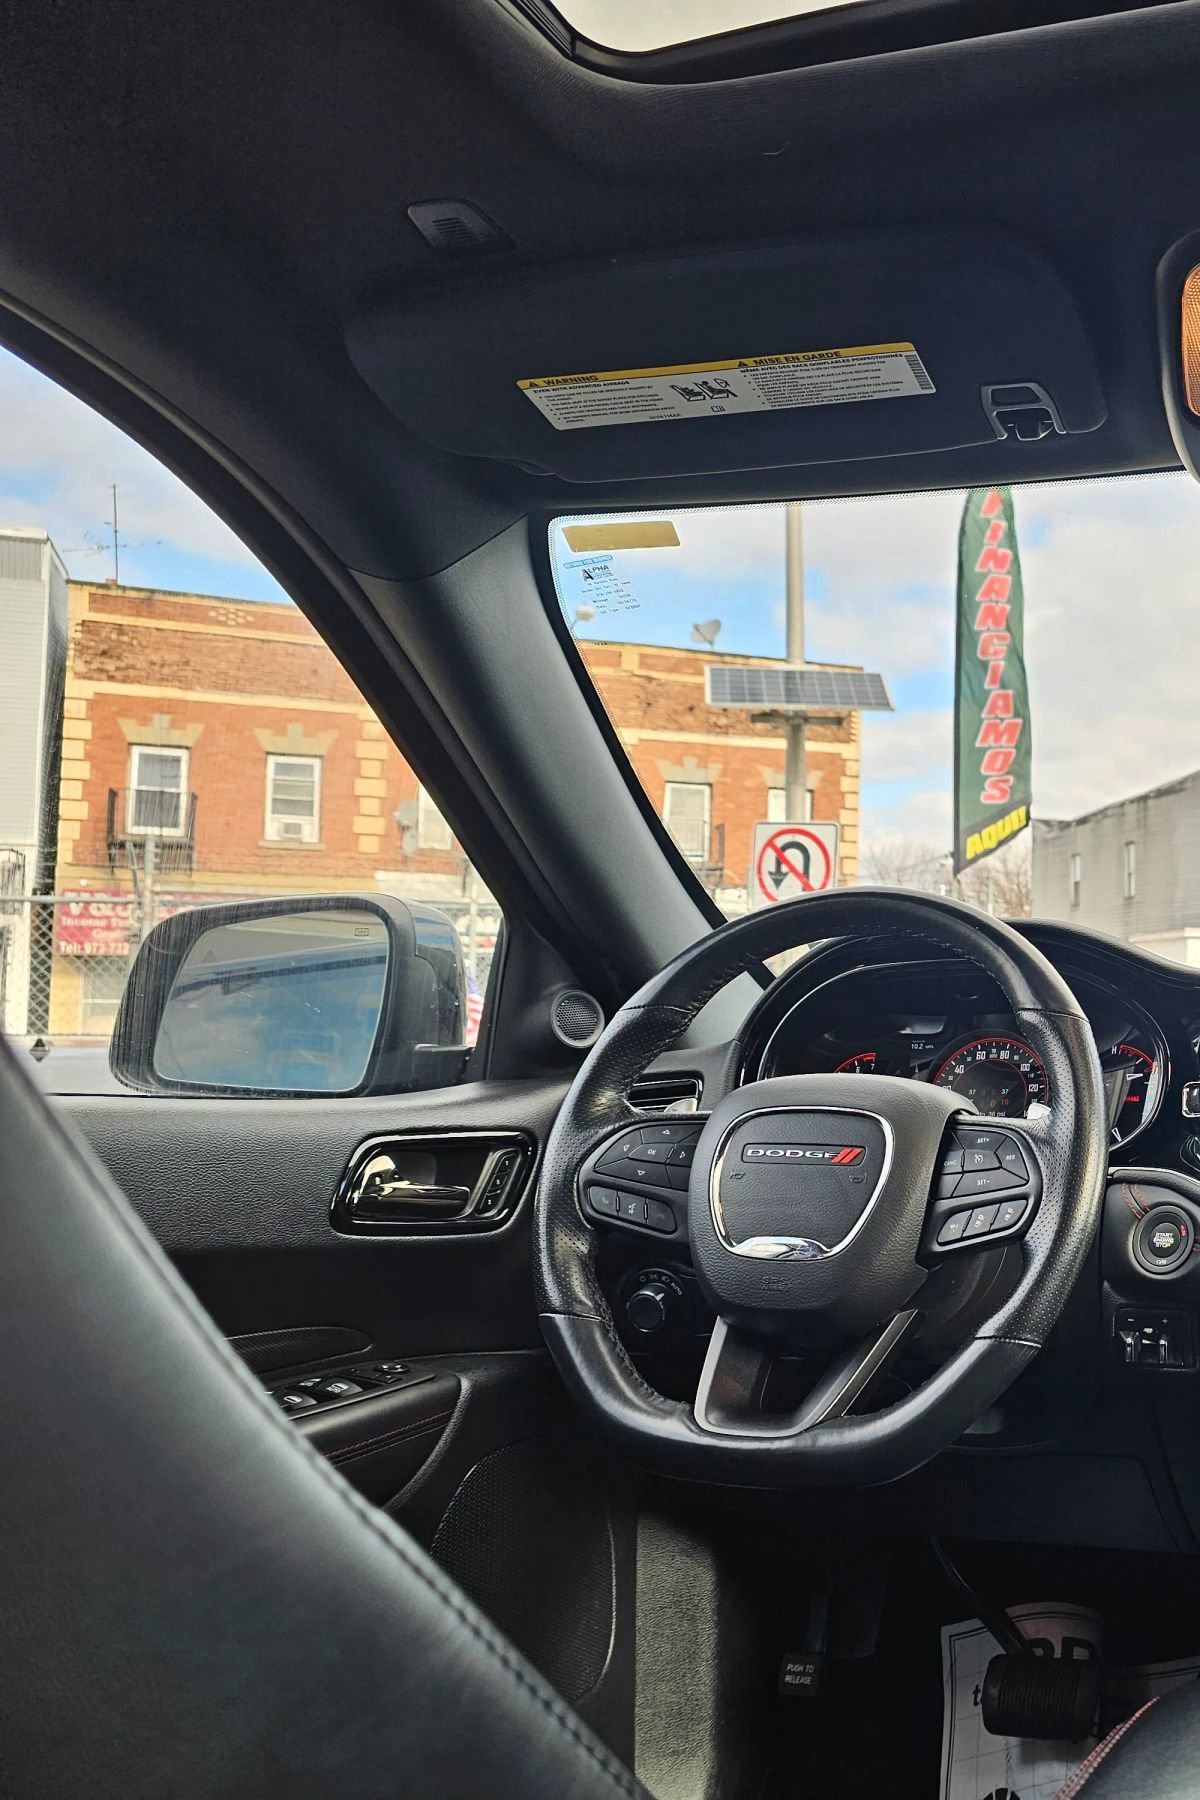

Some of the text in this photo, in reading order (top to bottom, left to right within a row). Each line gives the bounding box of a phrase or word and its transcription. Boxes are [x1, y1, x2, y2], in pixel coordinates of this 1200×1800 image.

[803, 351, 840, 360] GARDE
[544, 375, 599, 386] WARNING
[1000, 1050, 1009, 1059] 80
[1112, 1046, 1117, 1054] H
[976, 1051, 986, 1060] 60
[954, 1065, 964, 1074] 40
[1020, 1064, 1030, 1072] 100
[746, 1148, 840, 1158] DODGE
[670, 1282, 682, 1296] AUTO
[787, 1664, 804, 1672] PUSH
[785, 1675, 811, 1685] RELEASE
